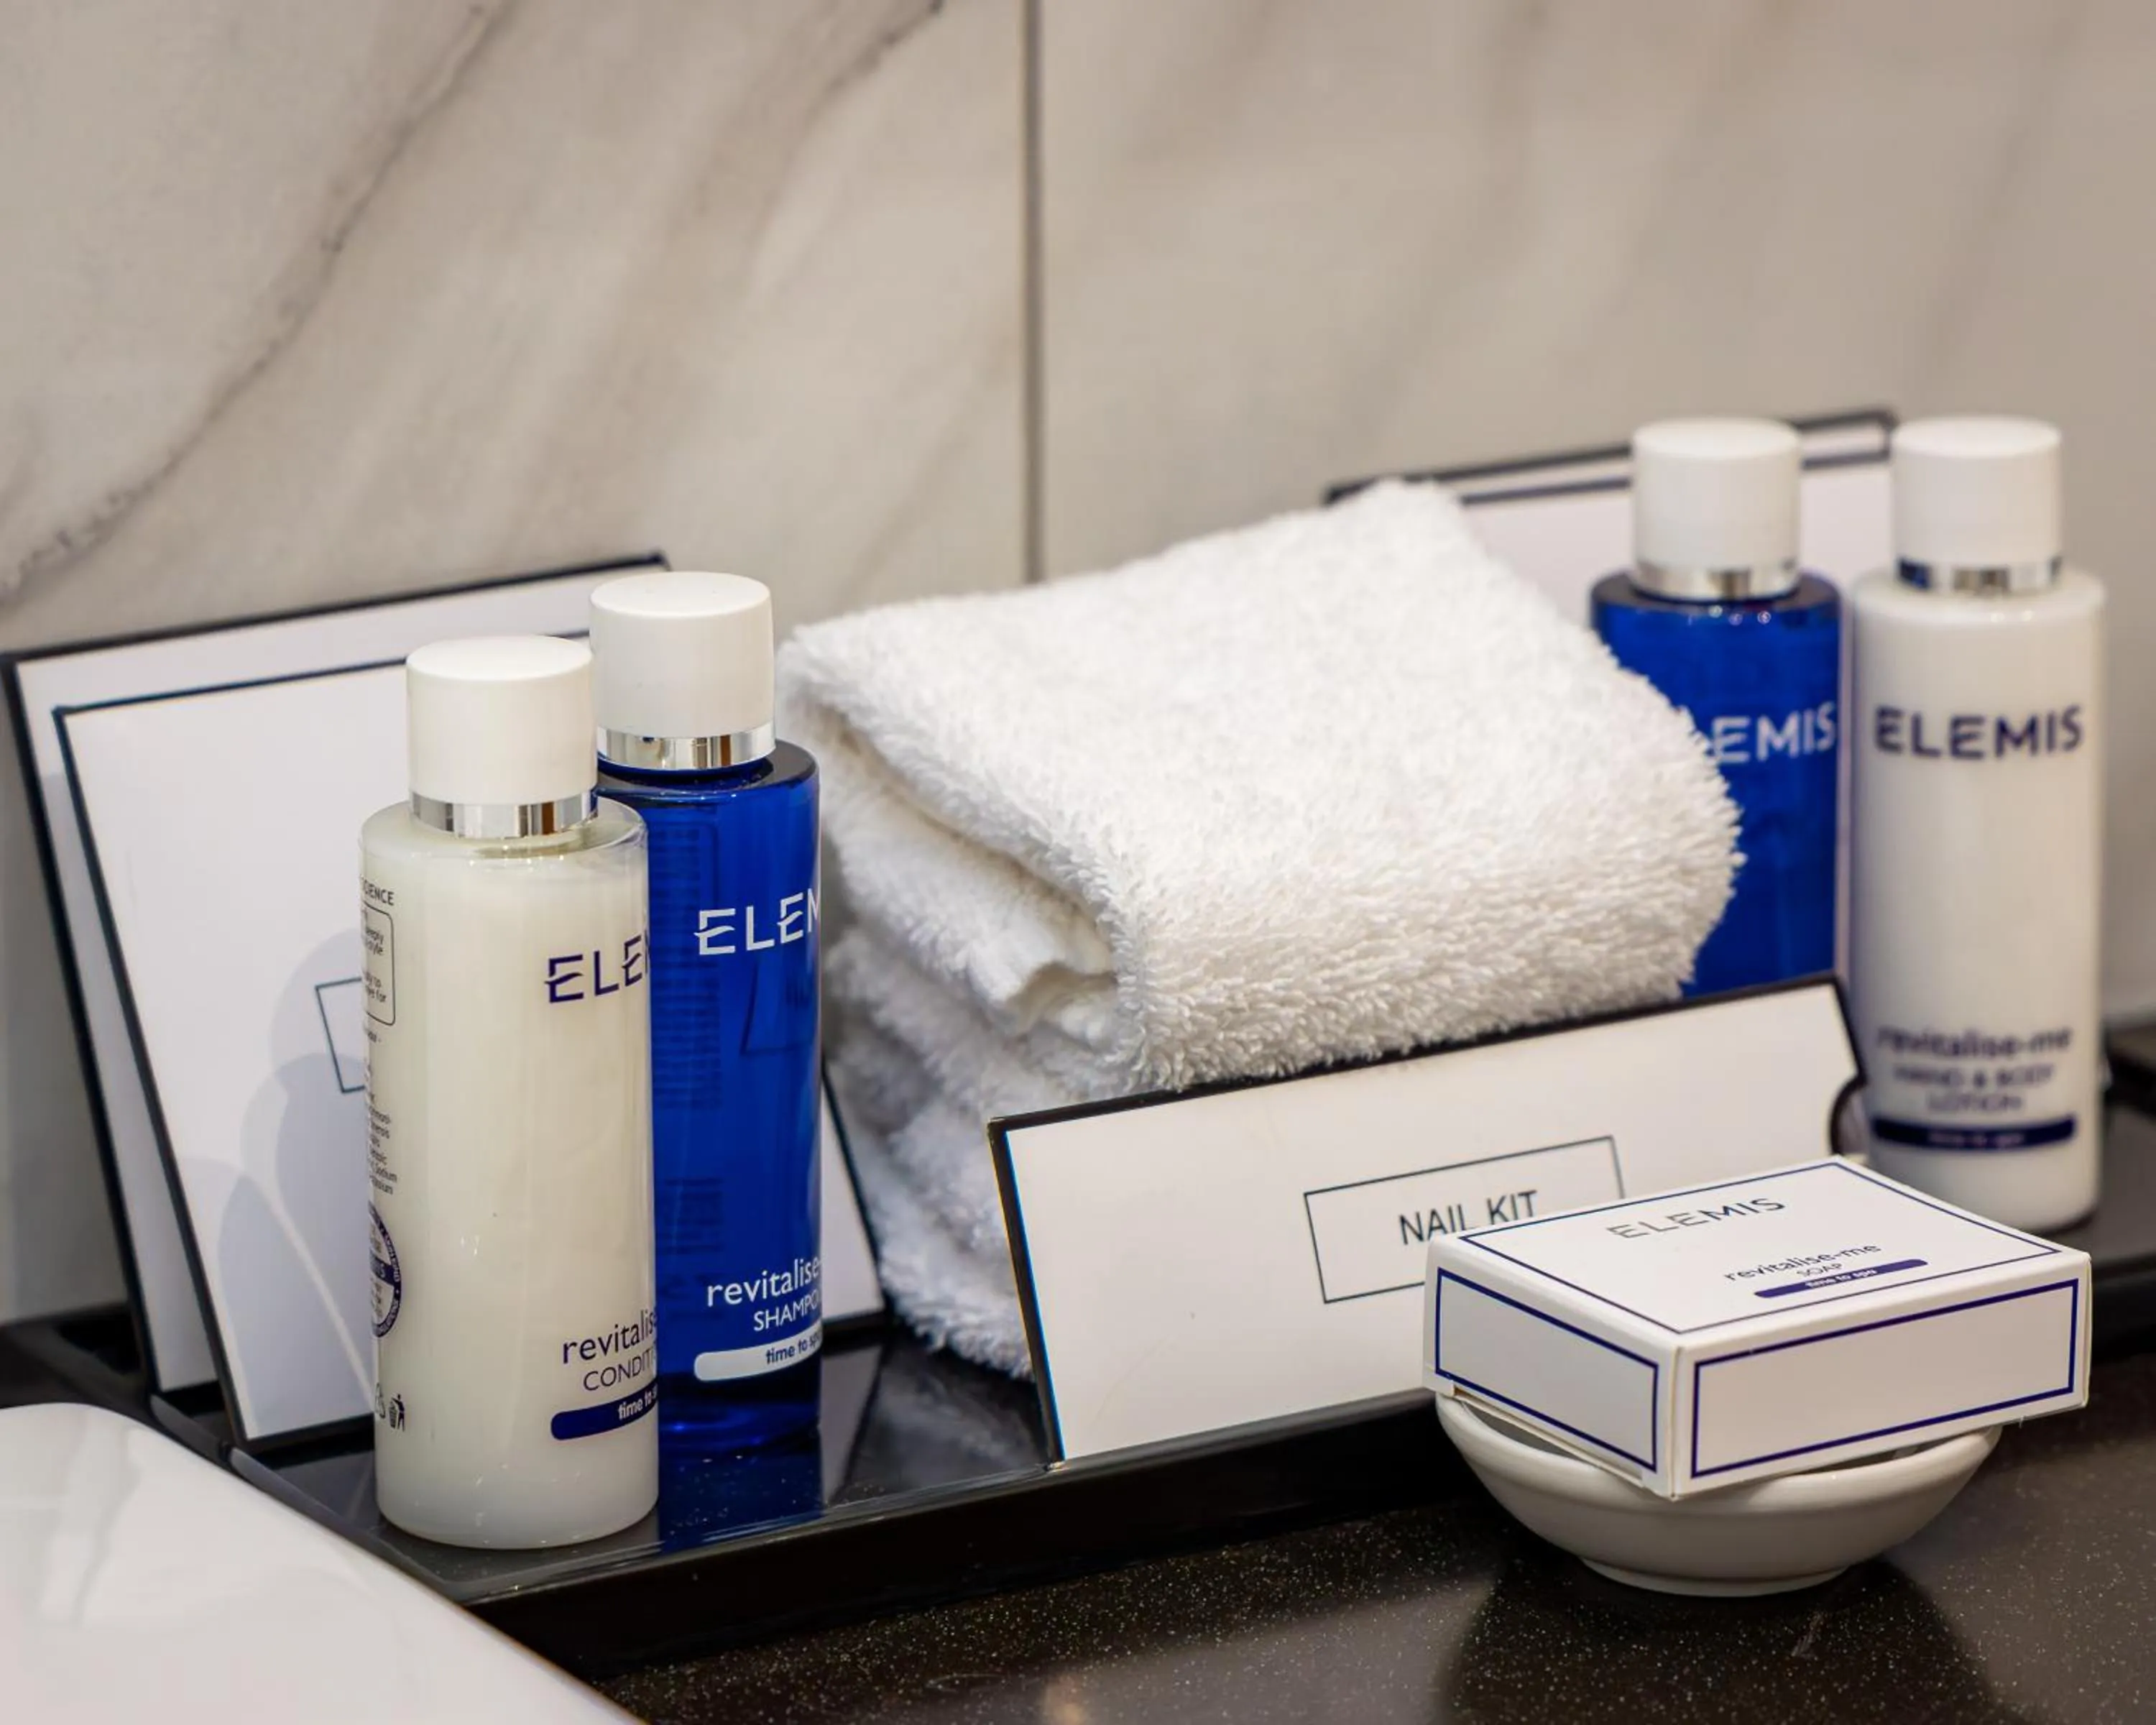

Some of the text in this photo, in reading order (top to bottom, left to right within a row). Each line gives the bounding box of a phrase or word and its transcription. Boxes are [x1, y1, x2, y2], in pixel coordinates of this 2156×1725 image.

[1709, 702, 1837, 764] EMIS
[1874, 704, 2081, 760] ELEMIS
[544, 930, 649, 1003] ELE
[1399, 1190, 1537, 1245] NAIL KIT
[1607, 1197, 1785, 1239] ELEMIS
[1724, 1243, 1881, 1282] revitalise-me
[1797, 1263, 1843, 1278] SOAP
[563, 1310, 655, 1364] revitalis
[765, 1345, 796, 1364] time
[798, 1339, 808, 1355] to
[583, 1348, 653, 1392] CONDIT
[617, 1397, 643, 1420] time
